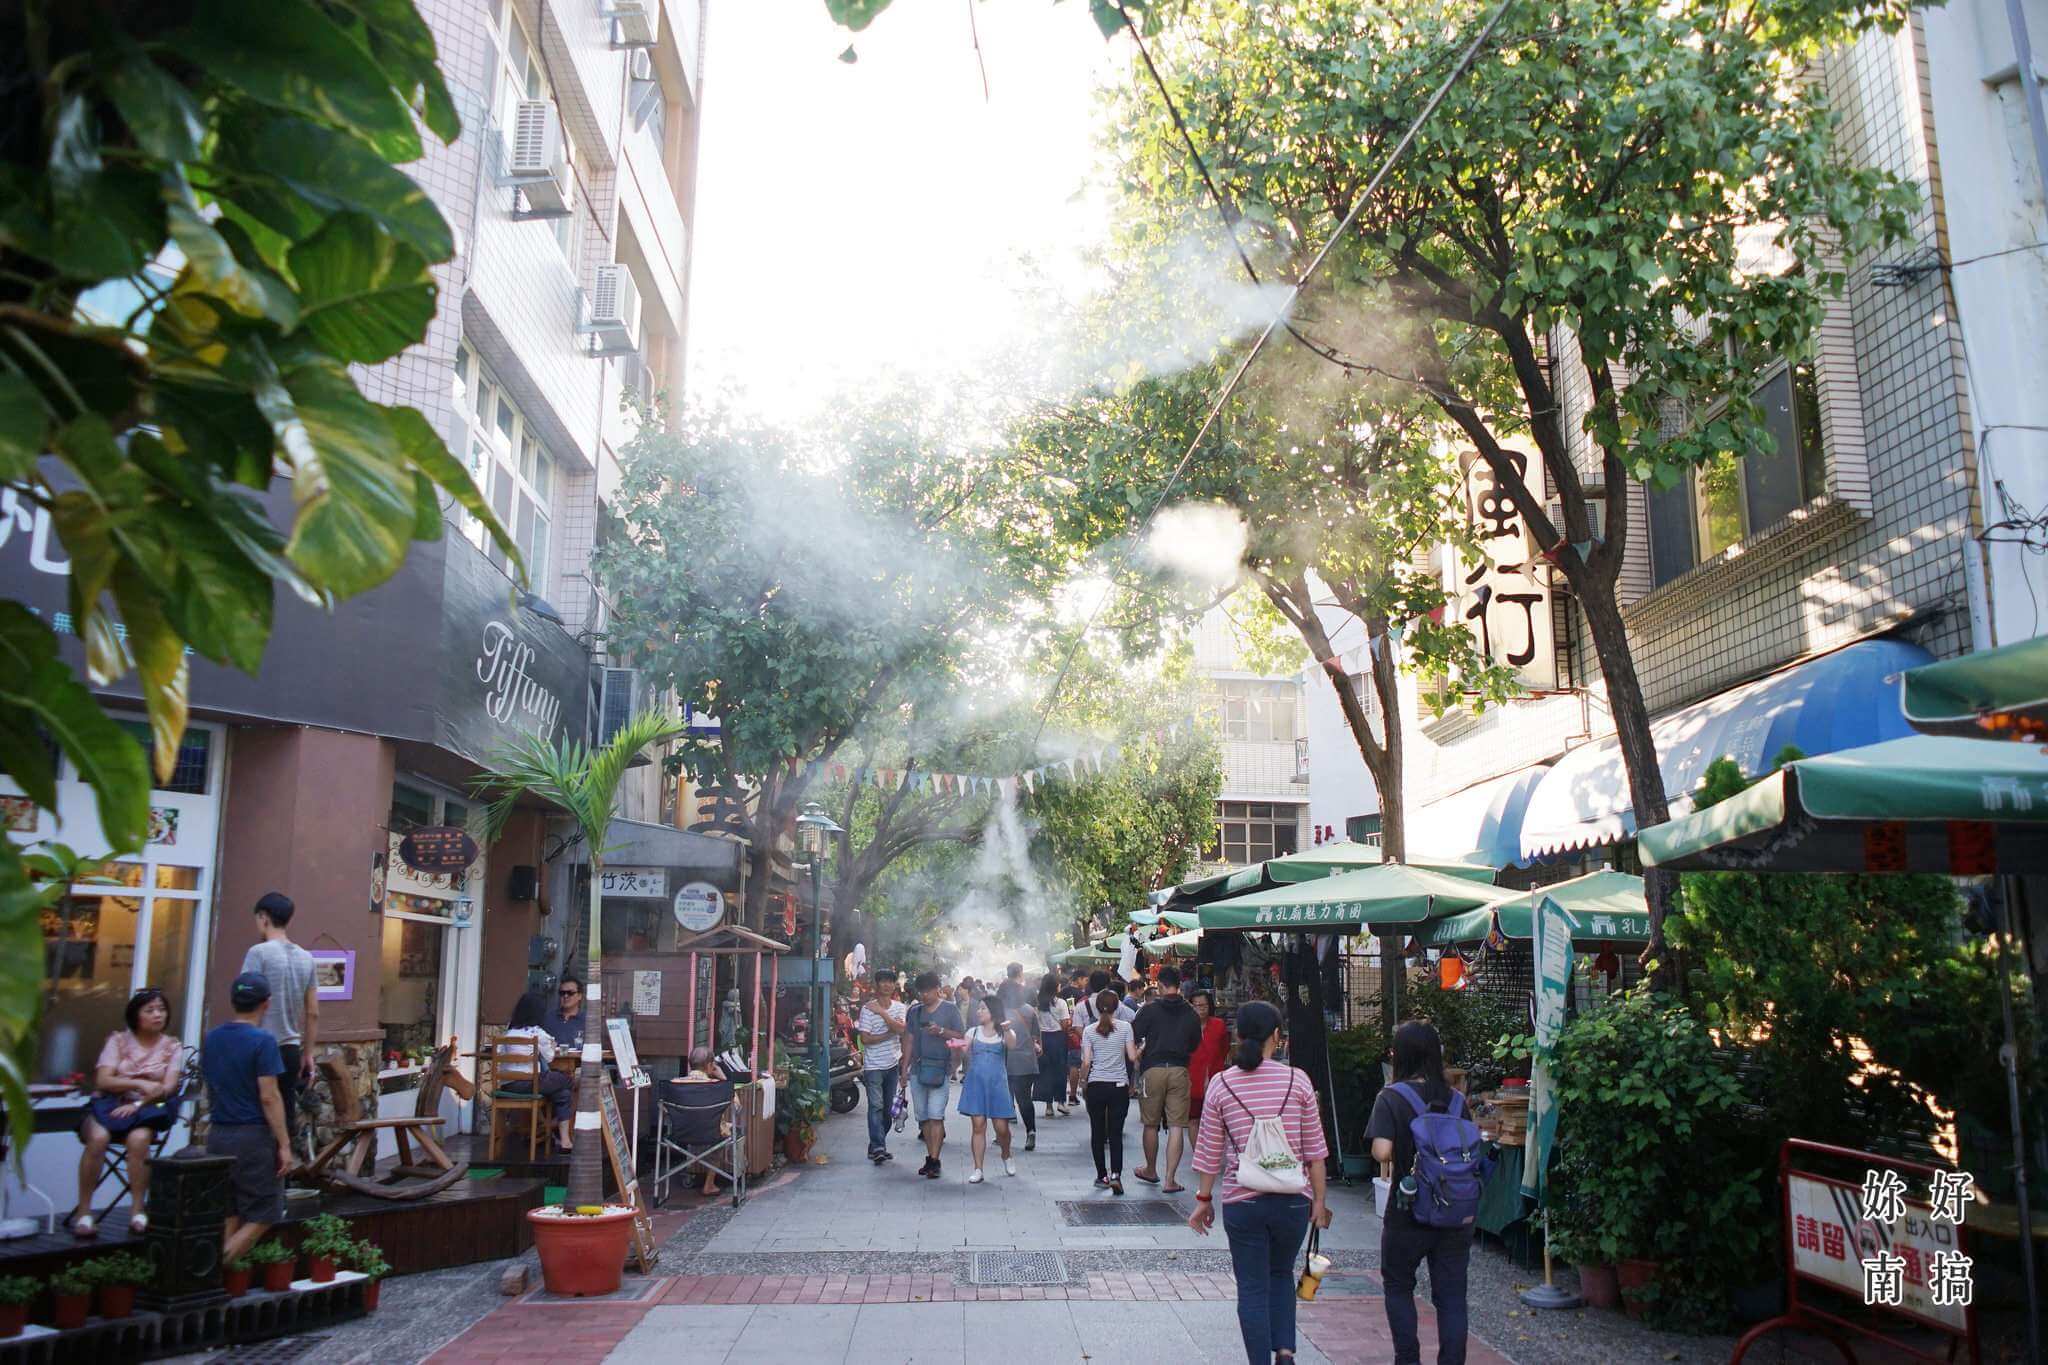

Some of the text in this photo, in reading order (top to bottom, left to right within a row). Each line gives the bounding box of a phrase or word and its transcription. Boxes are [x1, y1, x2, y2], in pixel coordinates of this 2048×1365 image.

[477, 621, 561, 744] Tiffany
[1796, 1214, 1846, 1262] 請留
[1904, 1216, 1952, 1246] 出入口
